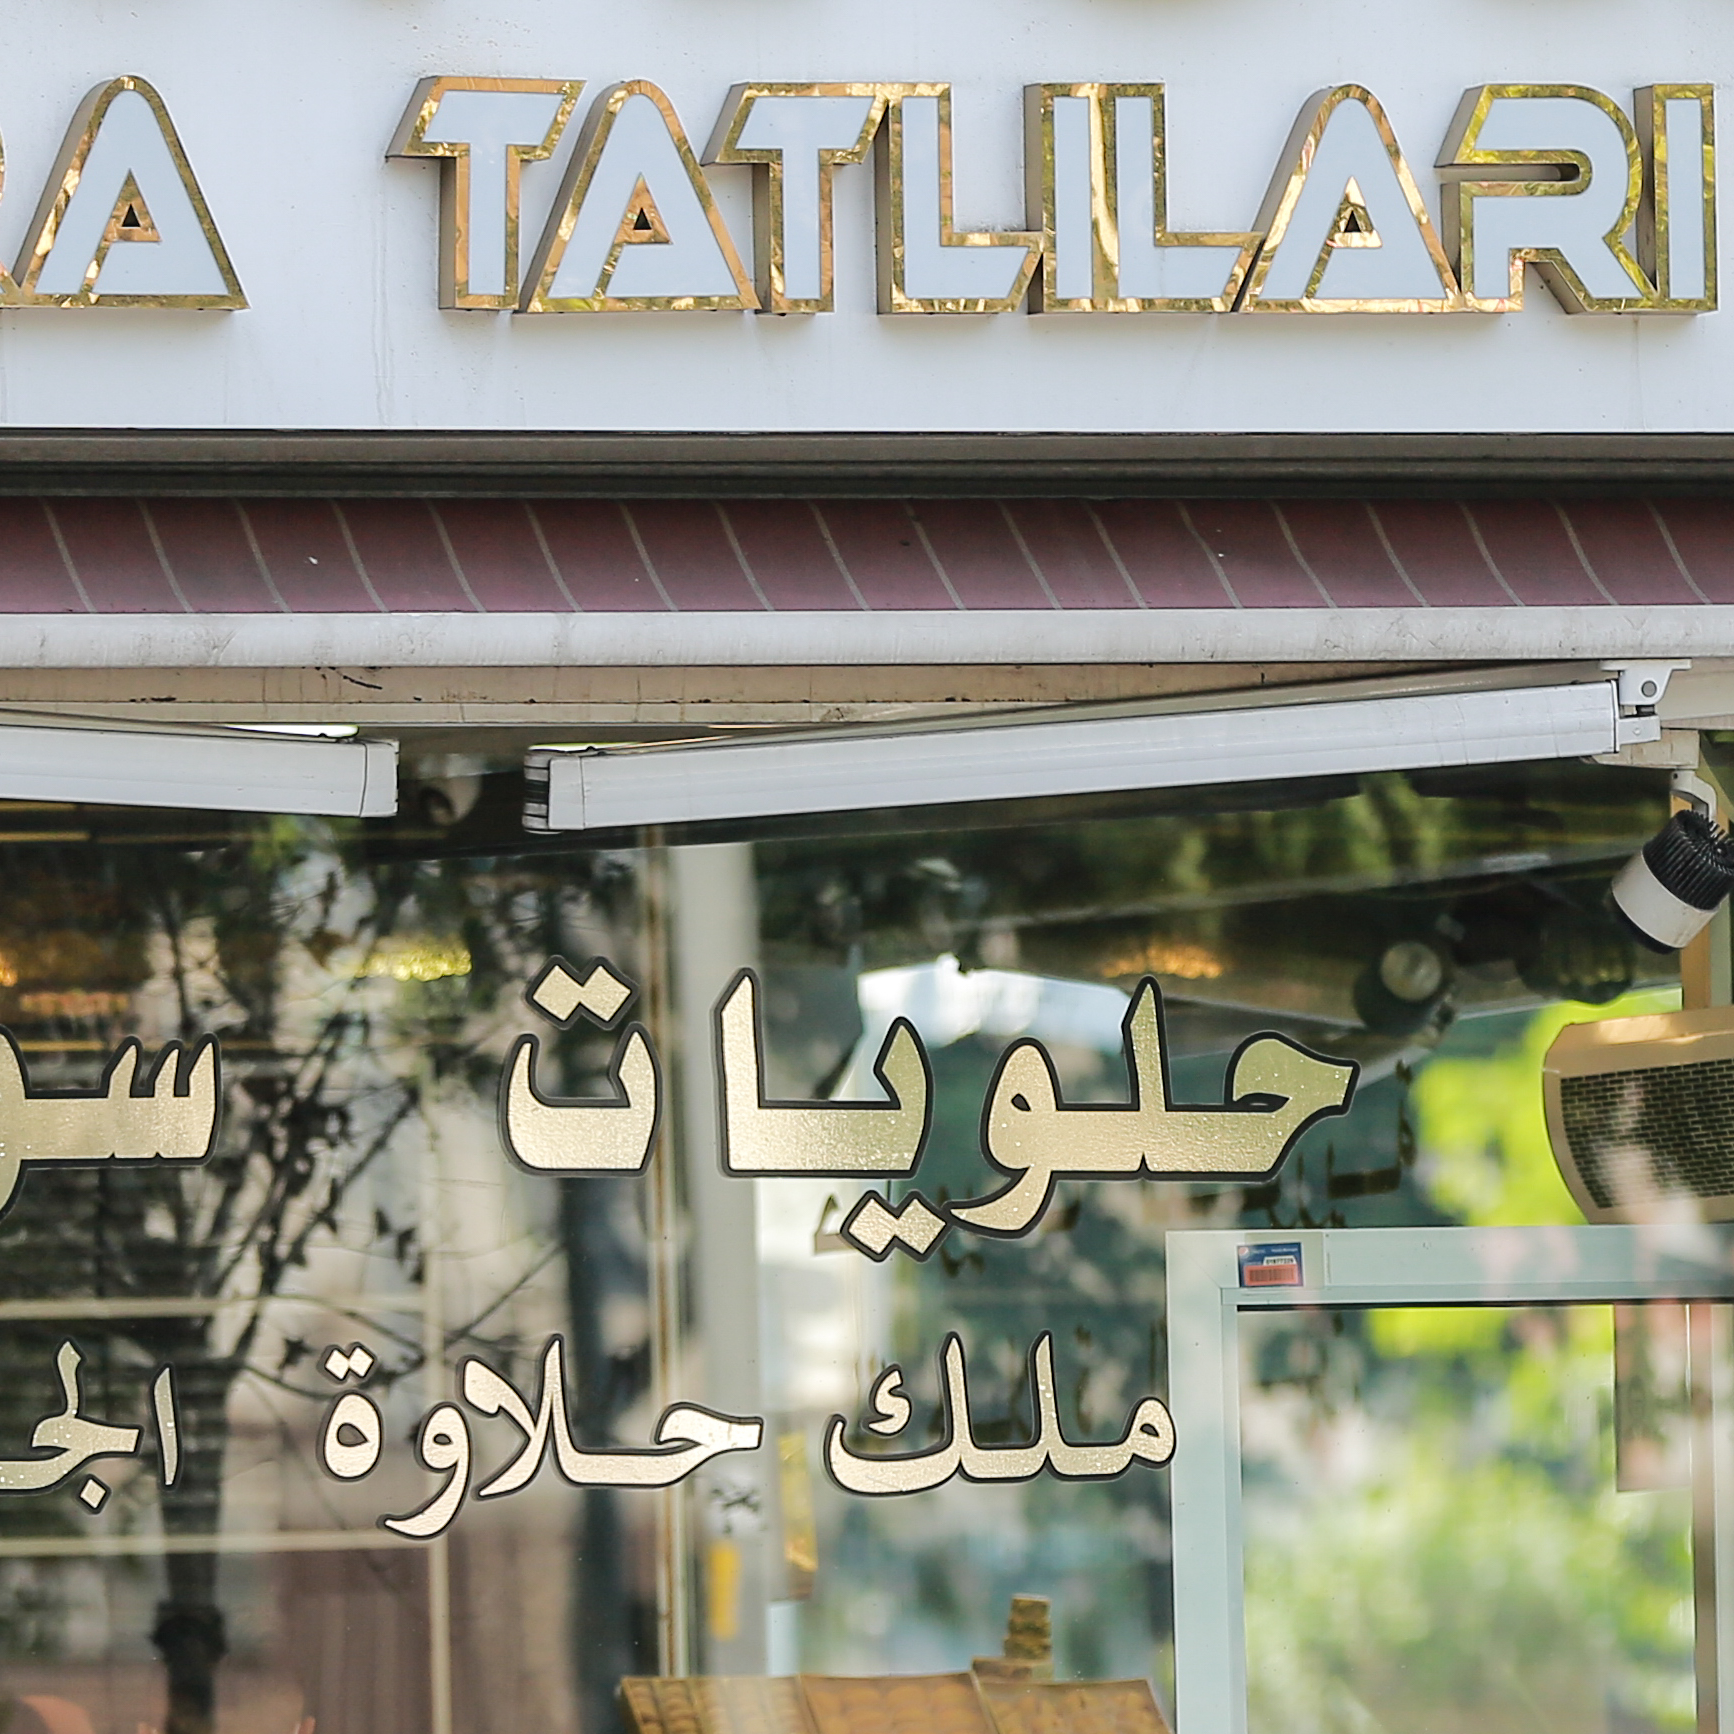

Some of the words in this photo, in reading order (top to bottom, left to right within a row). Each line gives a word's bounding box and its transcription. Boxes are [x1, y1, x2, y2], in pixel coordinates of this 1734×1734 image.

[385, 77, 1721, 318] TATLILARI
[499, 954, 1361, 1263] حلويات
[317, 1333, 766, 1541] حلاوة
[823, 1329, 1178, 1497] ملك
